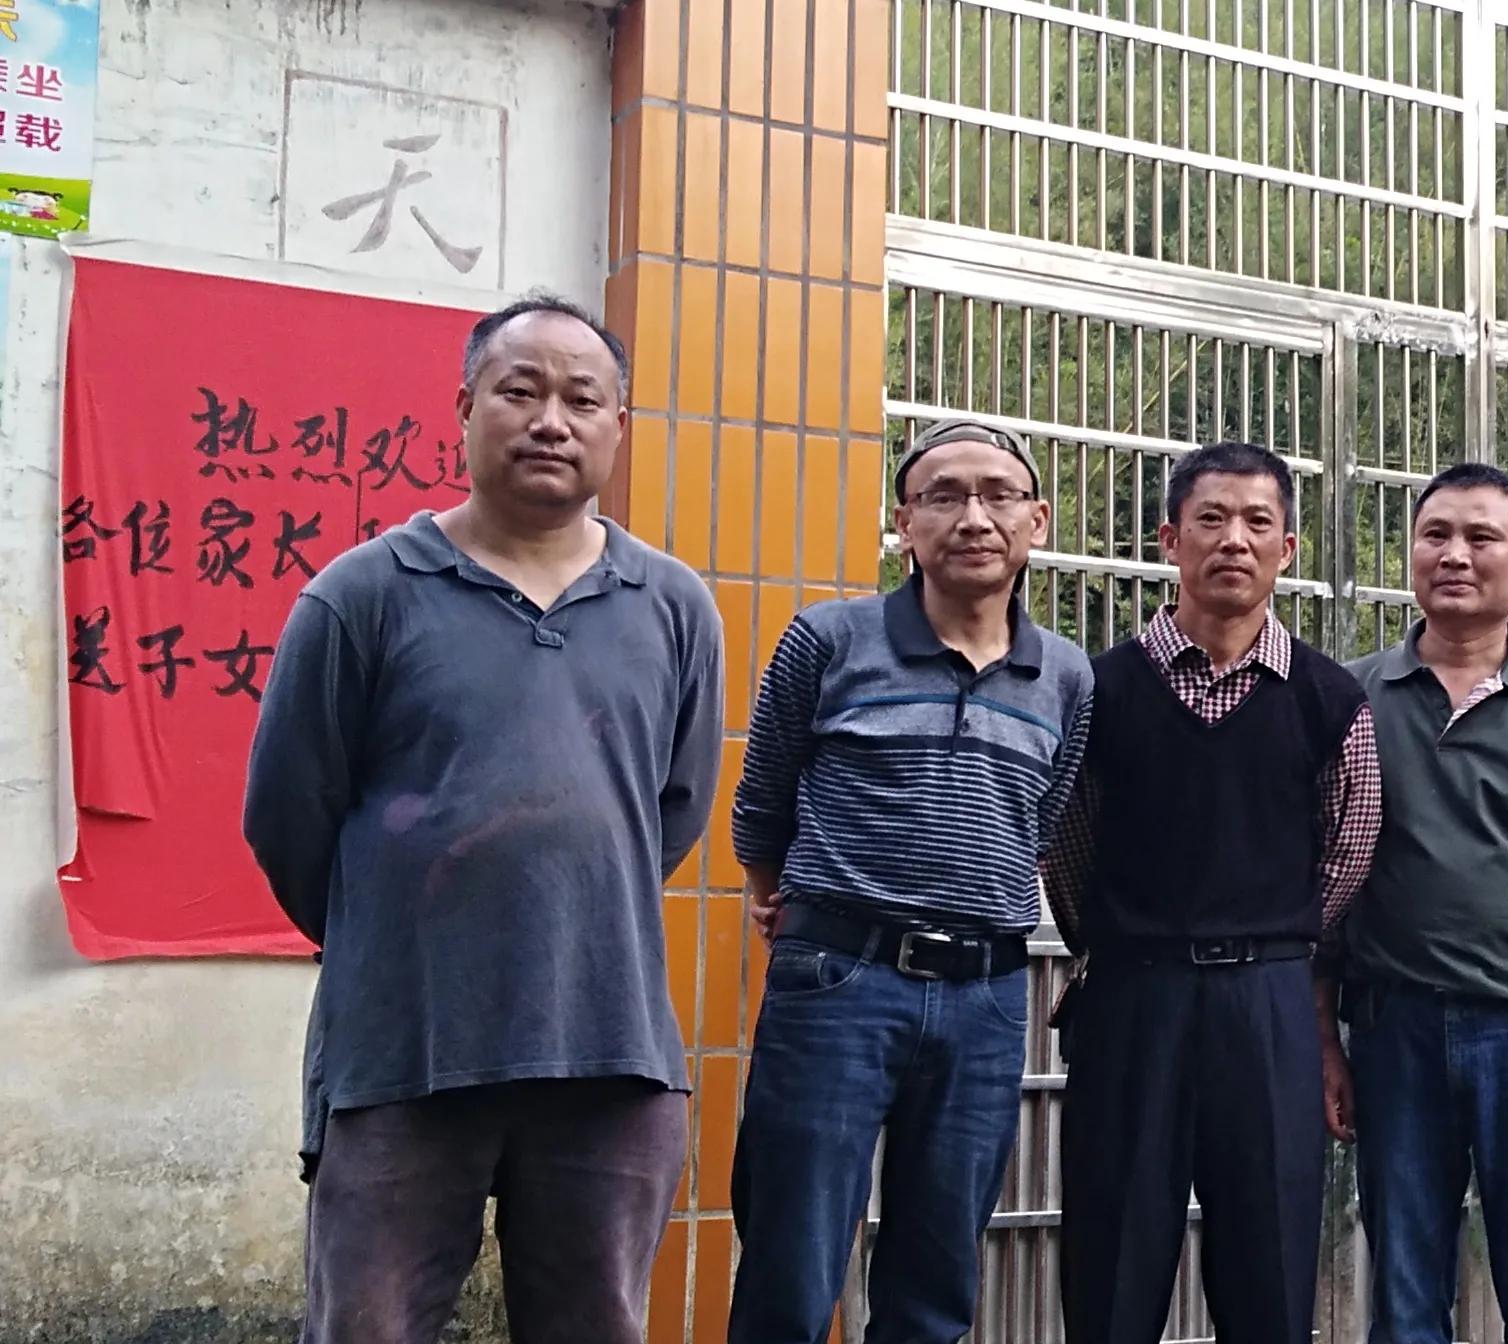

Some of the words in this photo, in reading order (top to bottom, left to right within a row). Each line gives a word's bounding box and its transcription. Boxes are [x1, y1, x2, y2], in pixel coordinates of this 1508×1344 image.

[0, 59, 63, 102] 坐
[0, 110, 63, 152] 载
[59, 494, 382, 589] 各位家长
